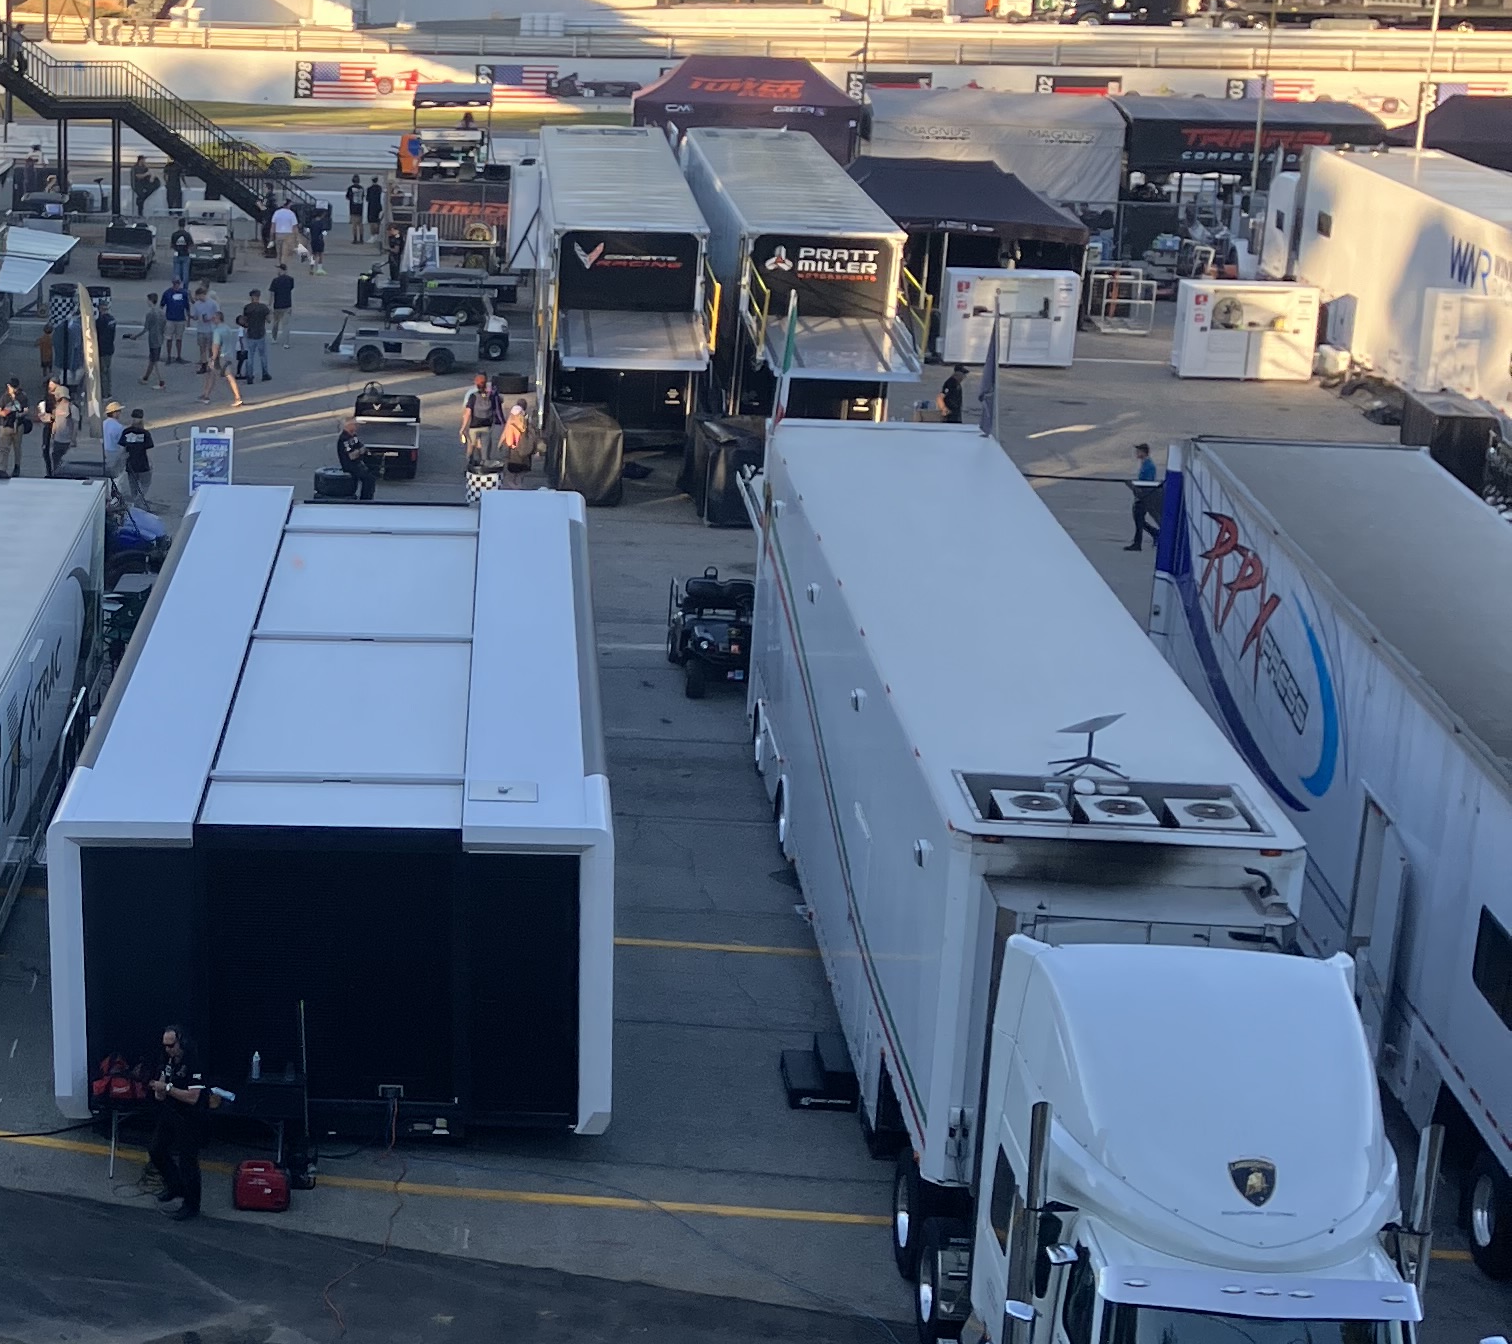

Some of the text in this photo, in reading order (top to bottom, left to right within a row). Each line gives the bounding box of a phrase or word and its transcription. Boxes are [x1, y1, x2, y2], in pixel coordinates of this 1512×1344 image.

[297, 61, 312, 97] 1998
[904, 125, 971, 137] MAGNUS
[1028, 129, 1095, 141] MAGNUS
[798, 247, 880, 262] PRATT
[797, 260, 878, 274] MILLER
